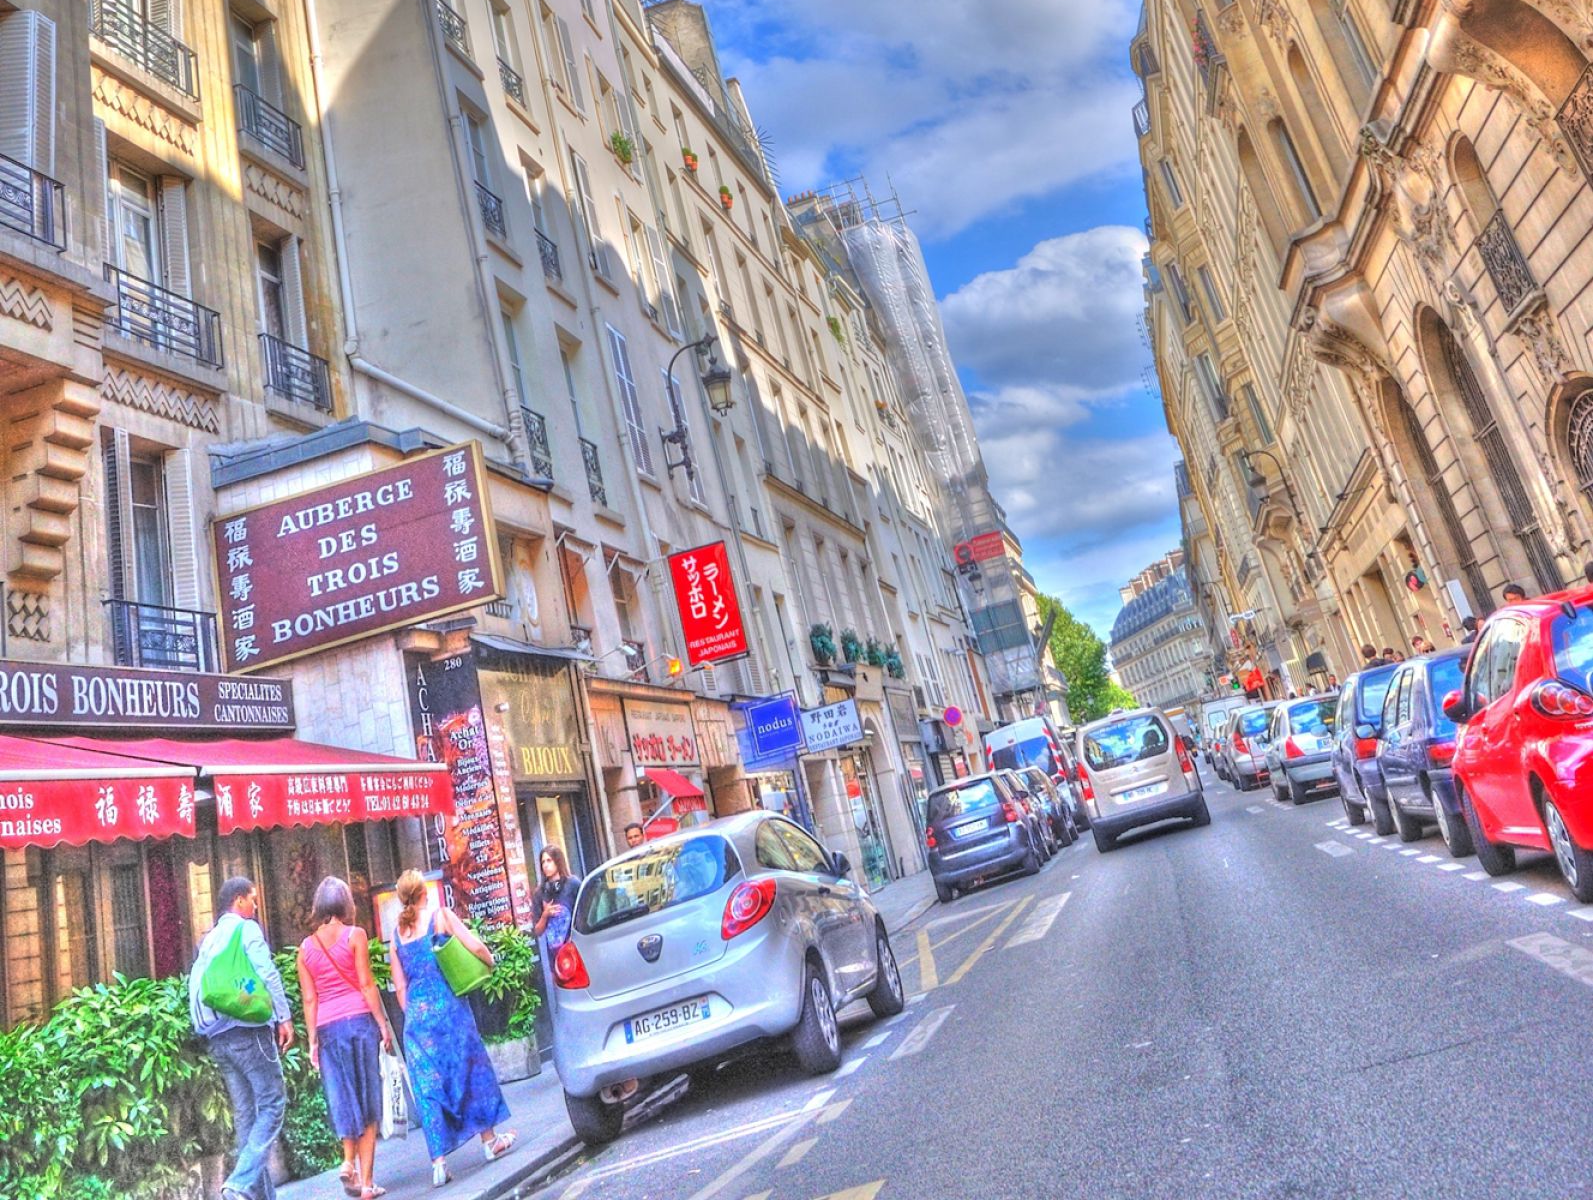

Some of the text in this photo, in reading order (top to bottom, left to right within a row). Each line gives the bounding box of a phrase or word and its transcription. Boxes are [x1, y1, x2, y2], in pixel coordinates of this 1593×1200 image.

[276, 479, 414, 538] AUBERGE
[318, 523, 378, 559] DES
[307, 552, 399, 597] TROIS
[682, 555, 707, 619] サッポロ
[271, 576, 440, 644] BONHEURS
[703, 562, 728, 629] ラーメン
[690, 629, 740, 649] RESTAURANT
[699, 640, 737, 657] JAPONAIS
[444, 657, 463, 671] 280
[72, 675, 200, 719] BONHEURS
[218, 682, 282, 702] SPECIALITES
[214, 703, 288, 724] CANTONNAISES
[757, 716, 793, 734] nodus
[808, 723, 859, 743] NODAIWA
[521, 747, 573, 775] BIJOUX
[635, 1003, 700, 1036] AG-259-BZ
